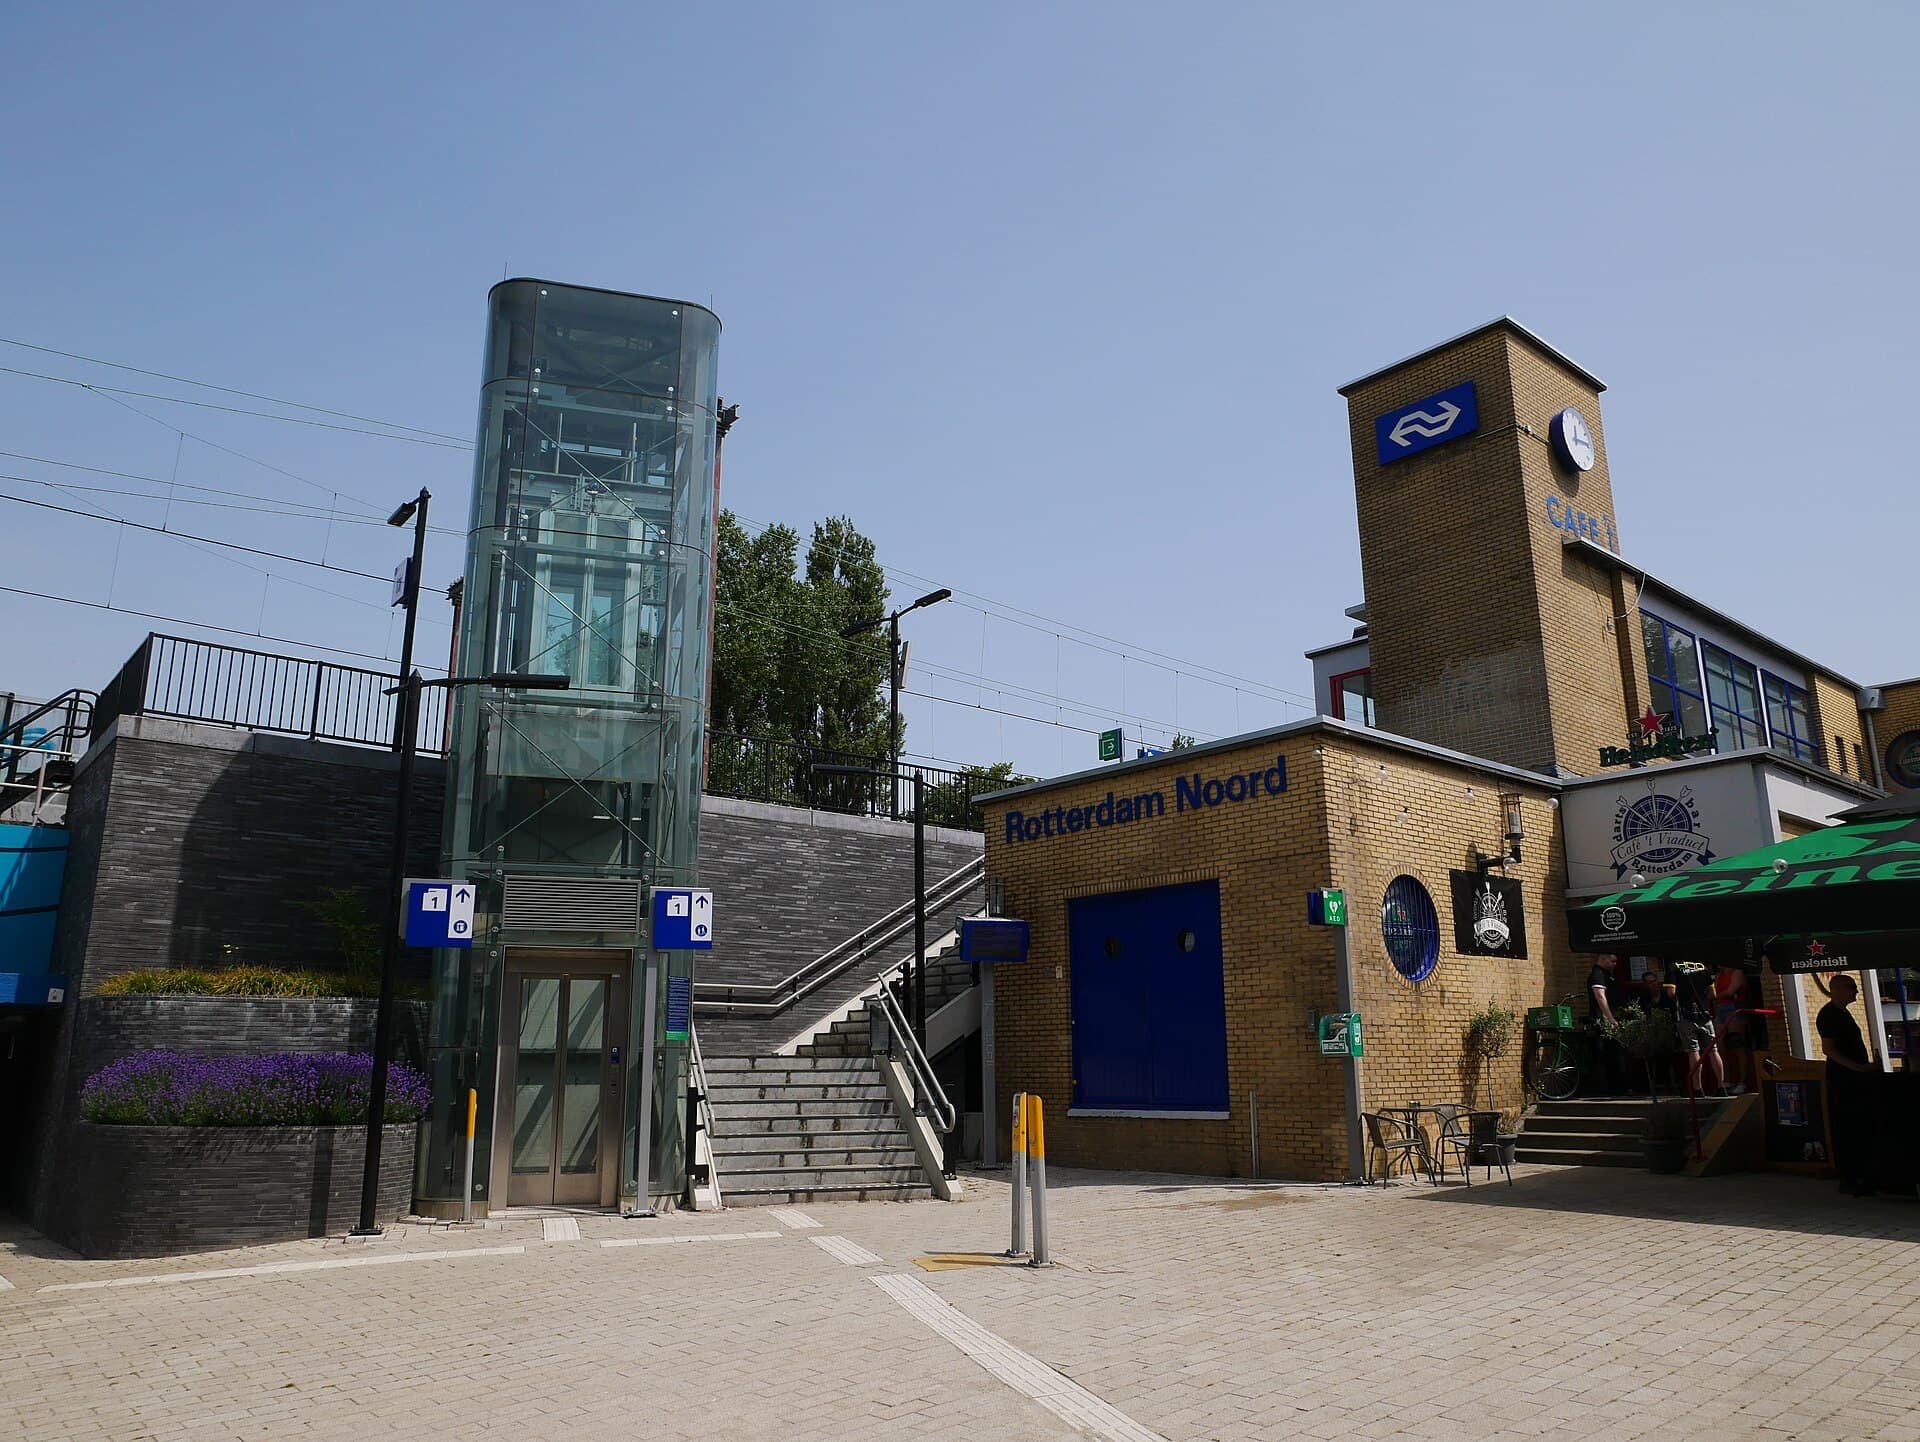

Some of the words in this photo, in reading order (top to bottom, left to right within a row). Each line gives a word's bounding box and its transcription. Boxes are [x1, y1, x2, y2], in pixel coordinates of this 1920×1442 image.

[1005, 791, 1165, 844] Rotterdam
[1175, 754, 1288, 813] Noord
[1685, 797, 1701, 829] bar
[1612, 806, 1627, 842] darts
[1616, 839, 1641, 860] Café
[1659, 832, 1705, 852] Viaduct
[1631, 852, 1693, 874] Rotterdam
[431, 896, 438, 909] 1
[674, 903, 681, 915] 1
